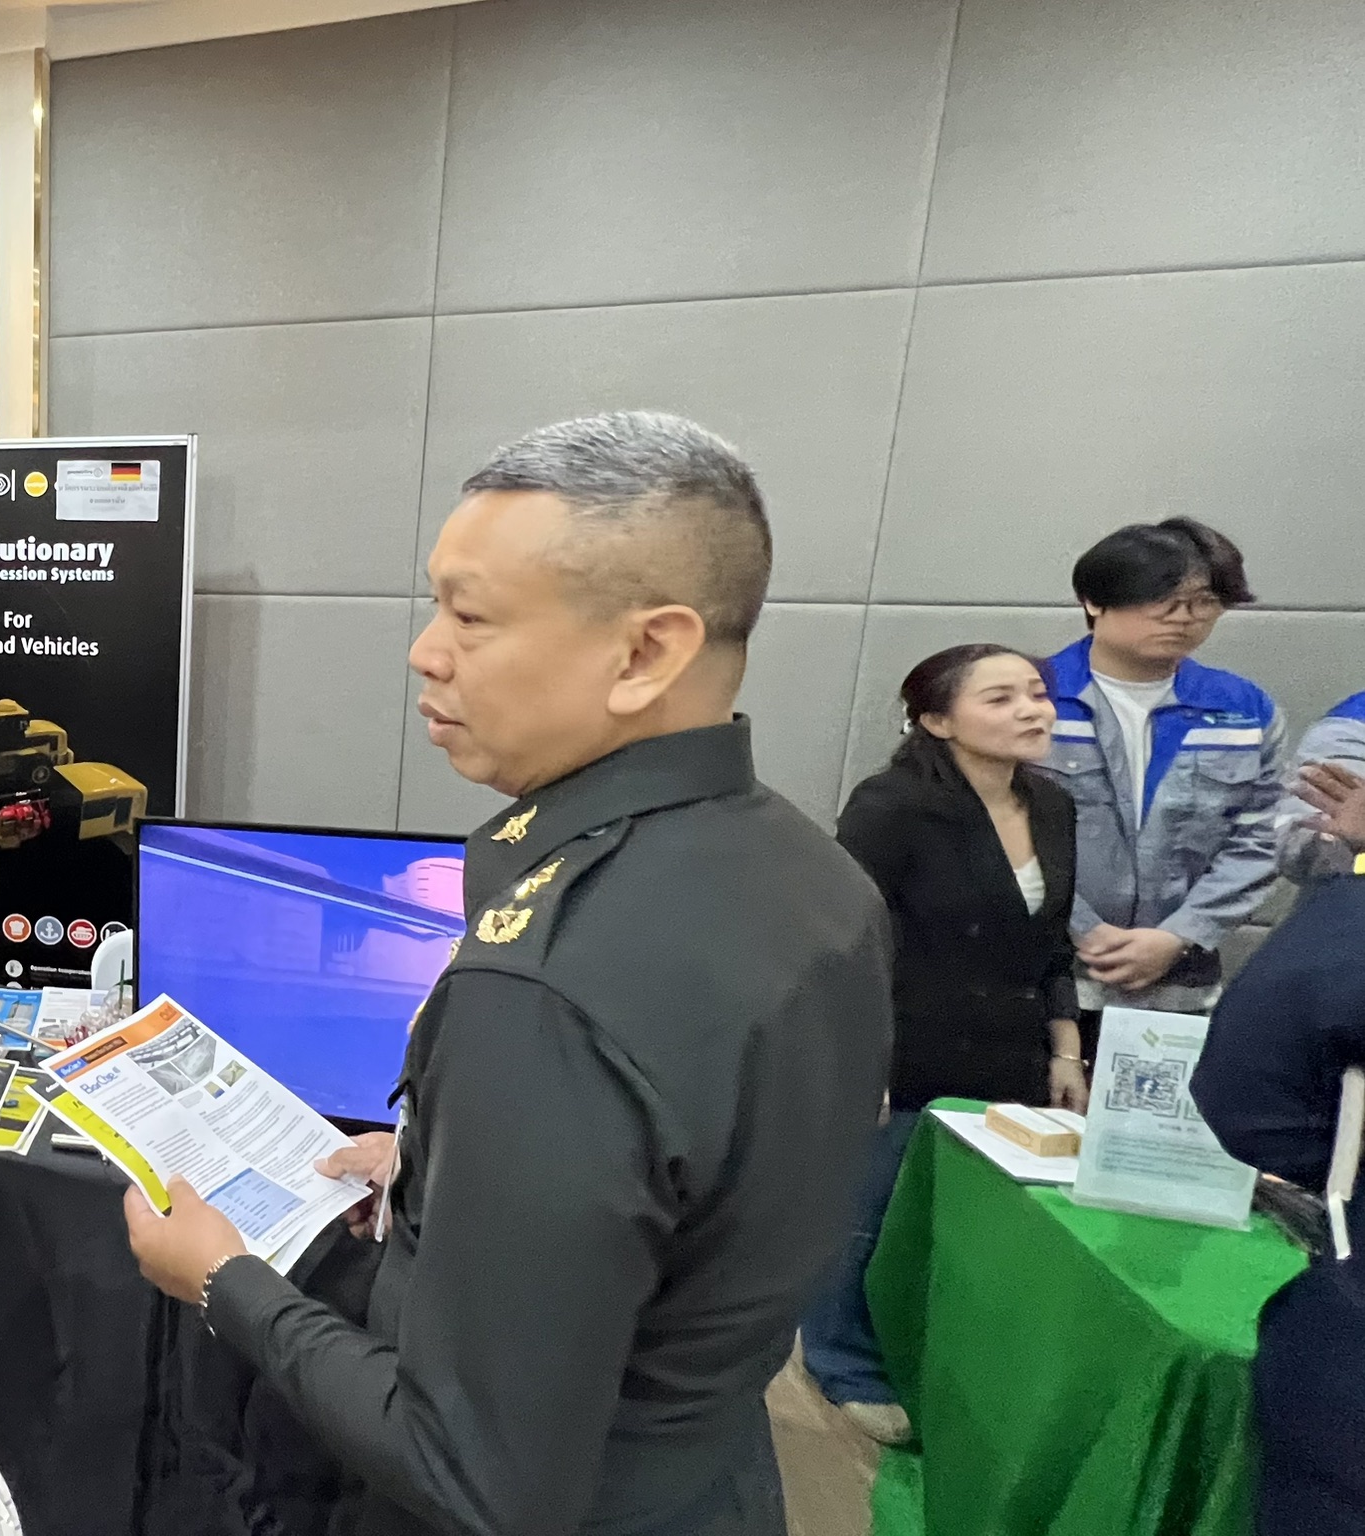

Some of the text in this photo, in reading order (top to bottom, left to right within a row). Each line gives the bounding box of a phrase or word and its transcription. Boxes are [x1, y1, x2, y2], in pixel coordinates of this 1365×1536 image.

[51, 567, 115, 584] Systems
[3, 610, 33, 629] For
[21, 636, 99, 656] Vehicles
